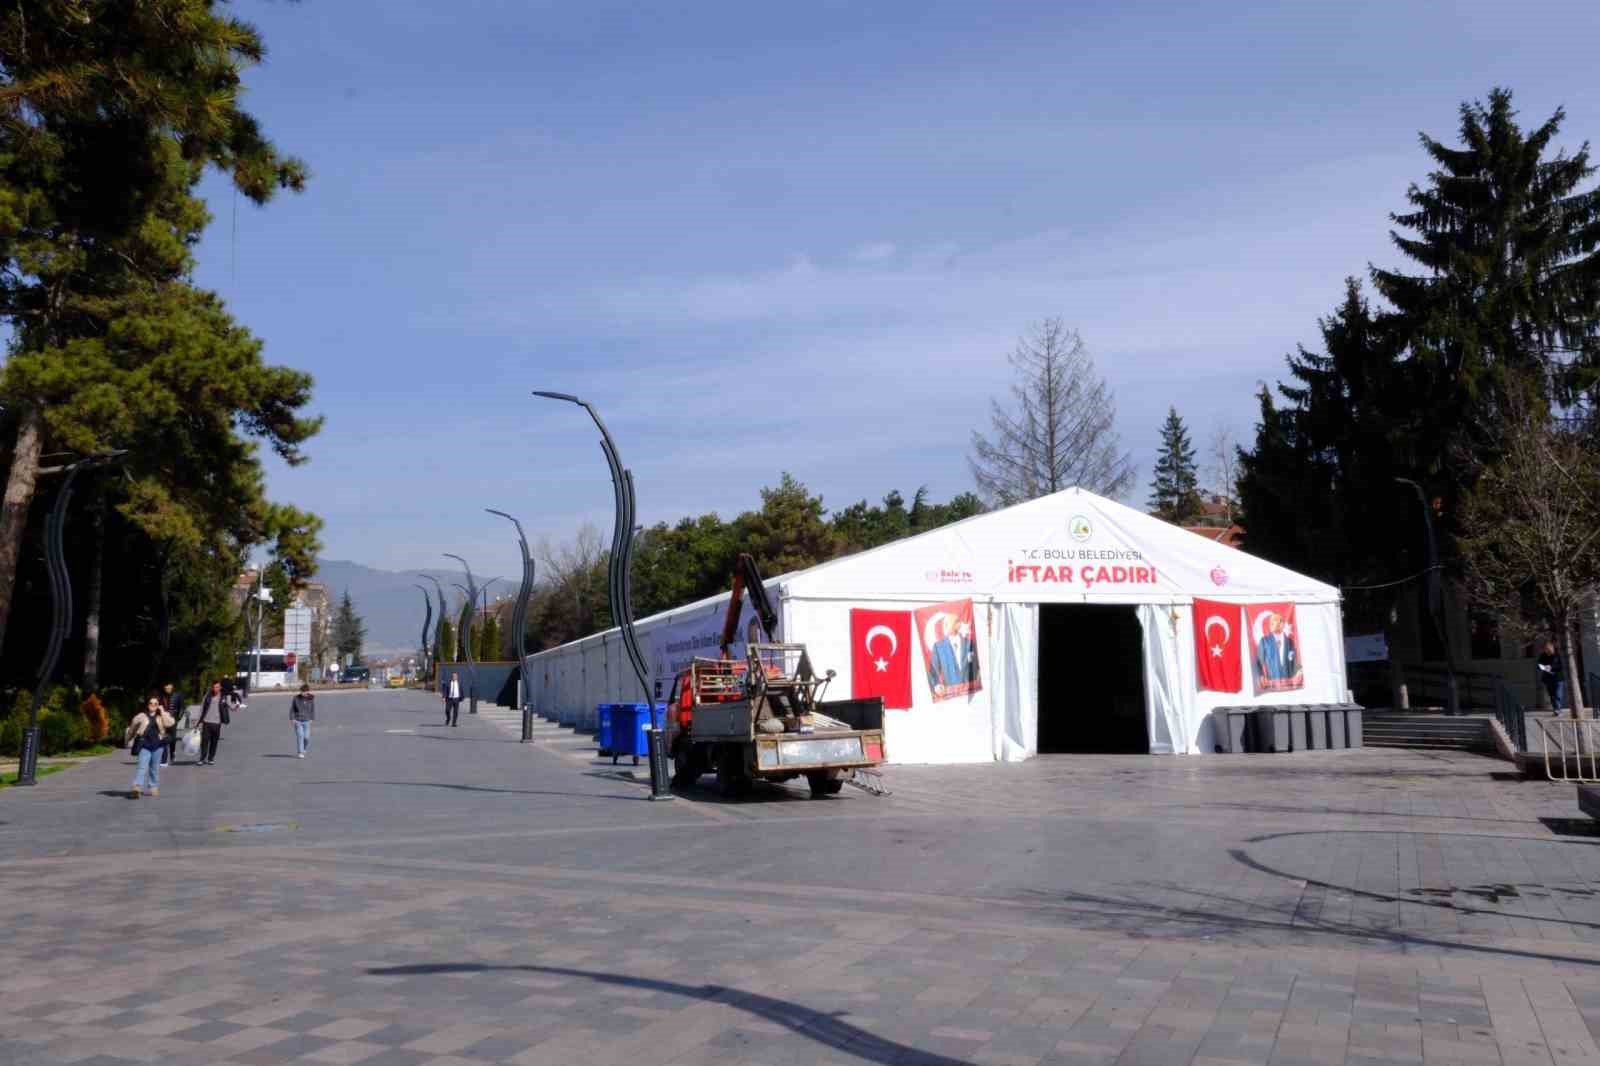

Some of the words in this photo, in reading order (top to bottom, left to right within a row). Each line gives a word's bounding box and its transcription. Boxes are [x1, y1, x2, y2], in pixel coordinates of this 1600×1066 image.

[1044, 550, 1075, 560] BOLU
[1008, 560, 1073, 583] İFTAR
[1080, 565, 1157, 588] ÇADIRI
